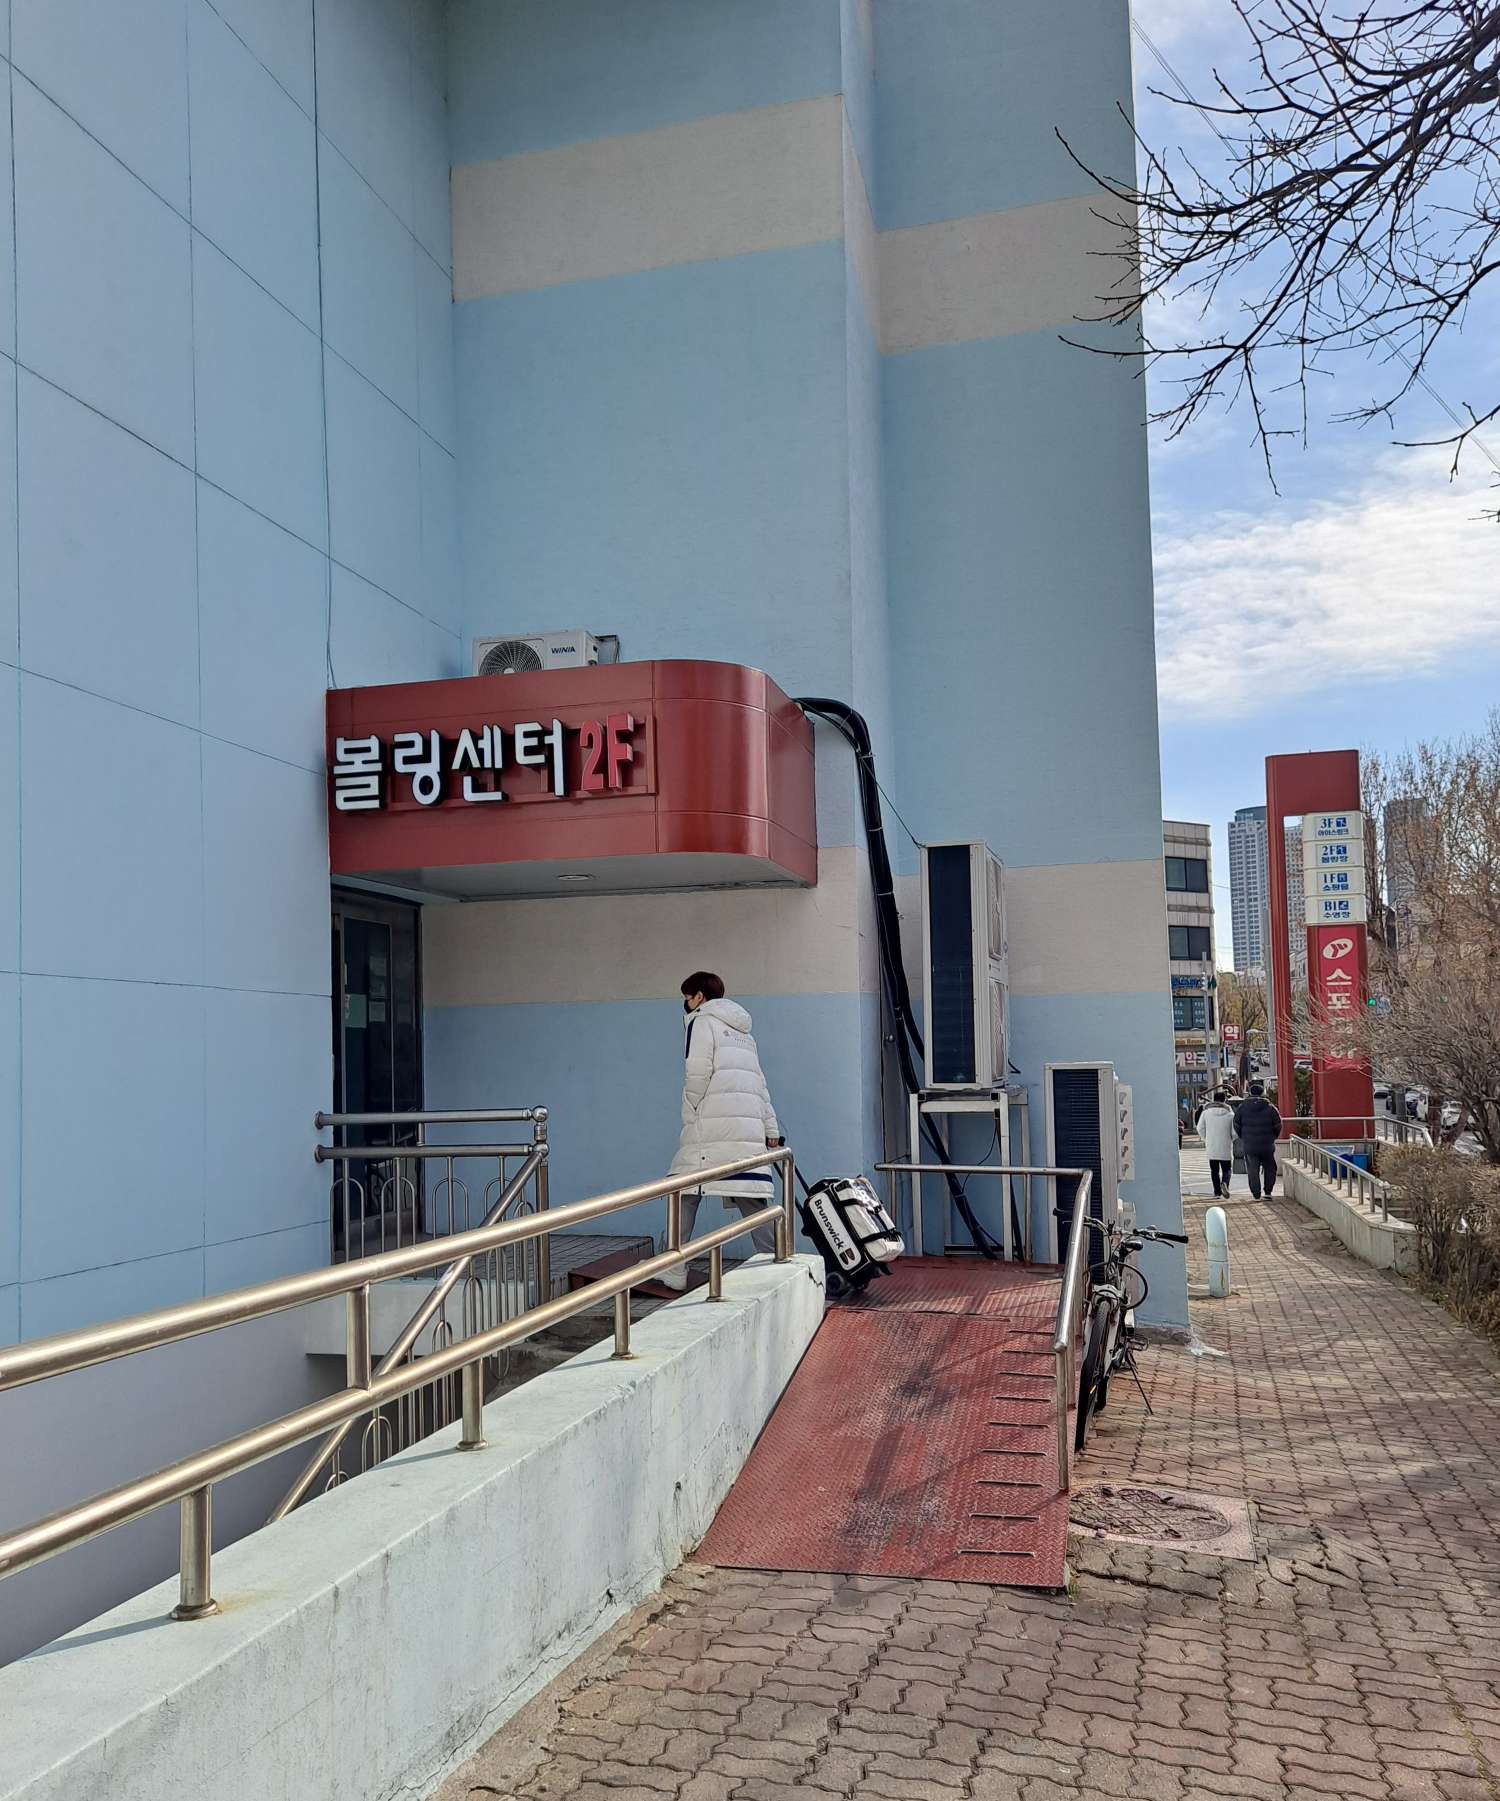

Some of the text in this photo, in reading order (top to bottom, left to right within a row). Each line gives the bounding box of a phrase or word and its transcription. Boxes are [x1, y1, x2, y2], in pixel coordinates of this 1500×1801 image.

[551, 646, 576, 654] WINIA
[334, 713, 634, 811] 볼링센터 2F
[1320, 817, 1334, 828] 3F
[1322, 845, 1336, 855] 2F
[1324, 873, 1336, 883] 1F
[1324, 901, 1337, 911] B1
[1224, 1026, 1239, 1040] 약
[815, 1199, 845, 1250] Brunswick
